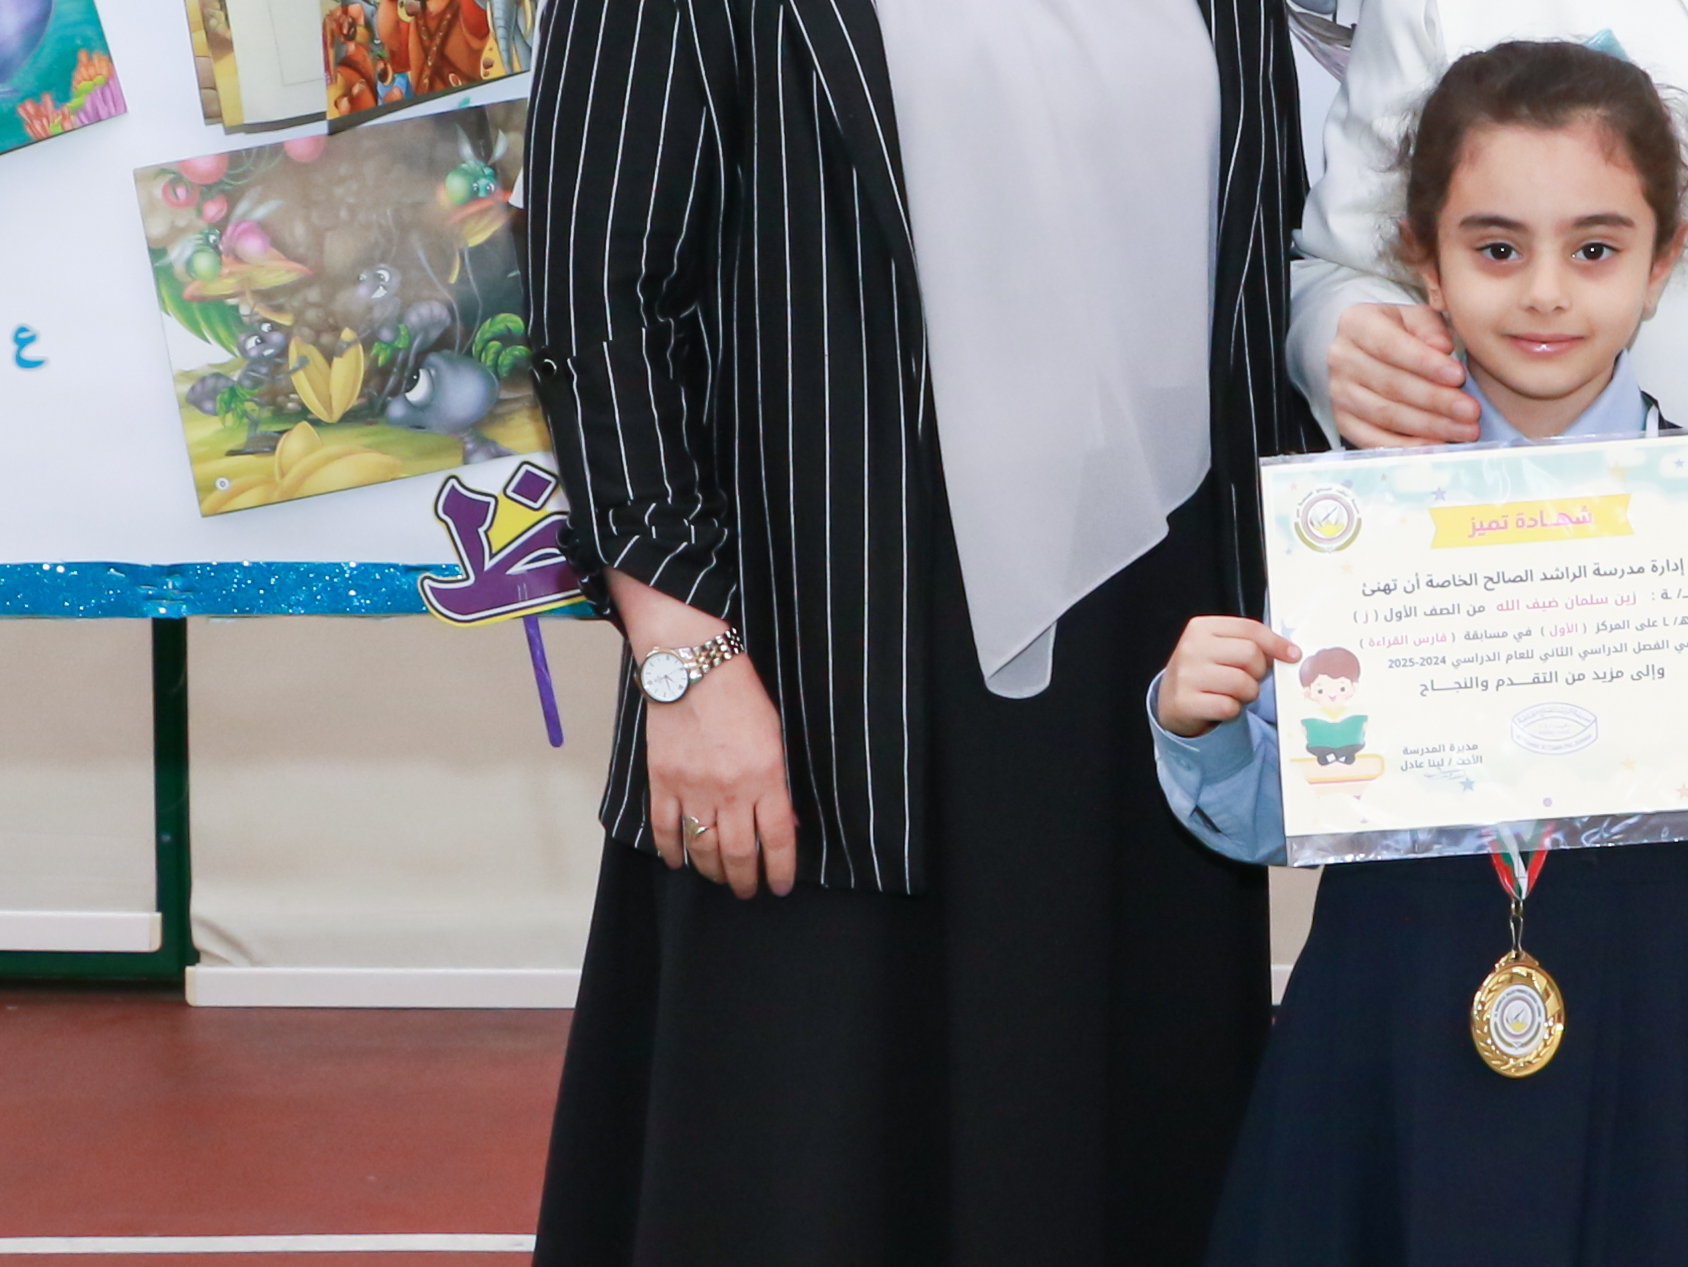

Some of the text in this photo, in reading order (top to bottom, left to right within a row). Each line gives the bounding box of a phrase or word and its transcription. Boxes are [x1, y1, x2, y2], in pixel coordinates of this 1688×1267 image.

[1468, 514, 1509, 539] تميز
[1539, 565, 1588, 583] الراشد
[1592, 562, 1645, 579] مدرسة
[1650, 557, 1685, 576] إدارة
[1403, 572, 1421, 594] أن
[1425, 572, 1478, 589] الخاصة
[1483, 569, 1534, 591] الصالح
[1496, 599, 1520, 612] الله
[1525, 597, 1559, 613] ضيف
[1564, 593, 1609, 610] سلمان
[1614, 591, 1637, 607] زين
[1383, 604, 1418, 623] الأول
[1423, 603, 1461, 617] الصف
[1466, 604, 1486, 617] من
[1595, 619, 1630, 635] المركز
[1635, 618, 1658, 632] على
[1463, 629, 1508, 642] مسابقة
[1512, 626, 1532, 642] في
[1539, 646, 1573, 663] الثاني
[1578, 642, 1628, 661] الدراسي
[1632, 639, 1669, 654] الفصل
[1451, 651, 1501, 669] الدراسي
[1505, 648, 1534, 664] للعام
[1565, 672, 1586, 686] من
[1591, 670, 1624, 683] مزيد
[1630, 663, 1665, 682] وإلى
[1402, 742, 1479, 756] مديرة المدرسة
